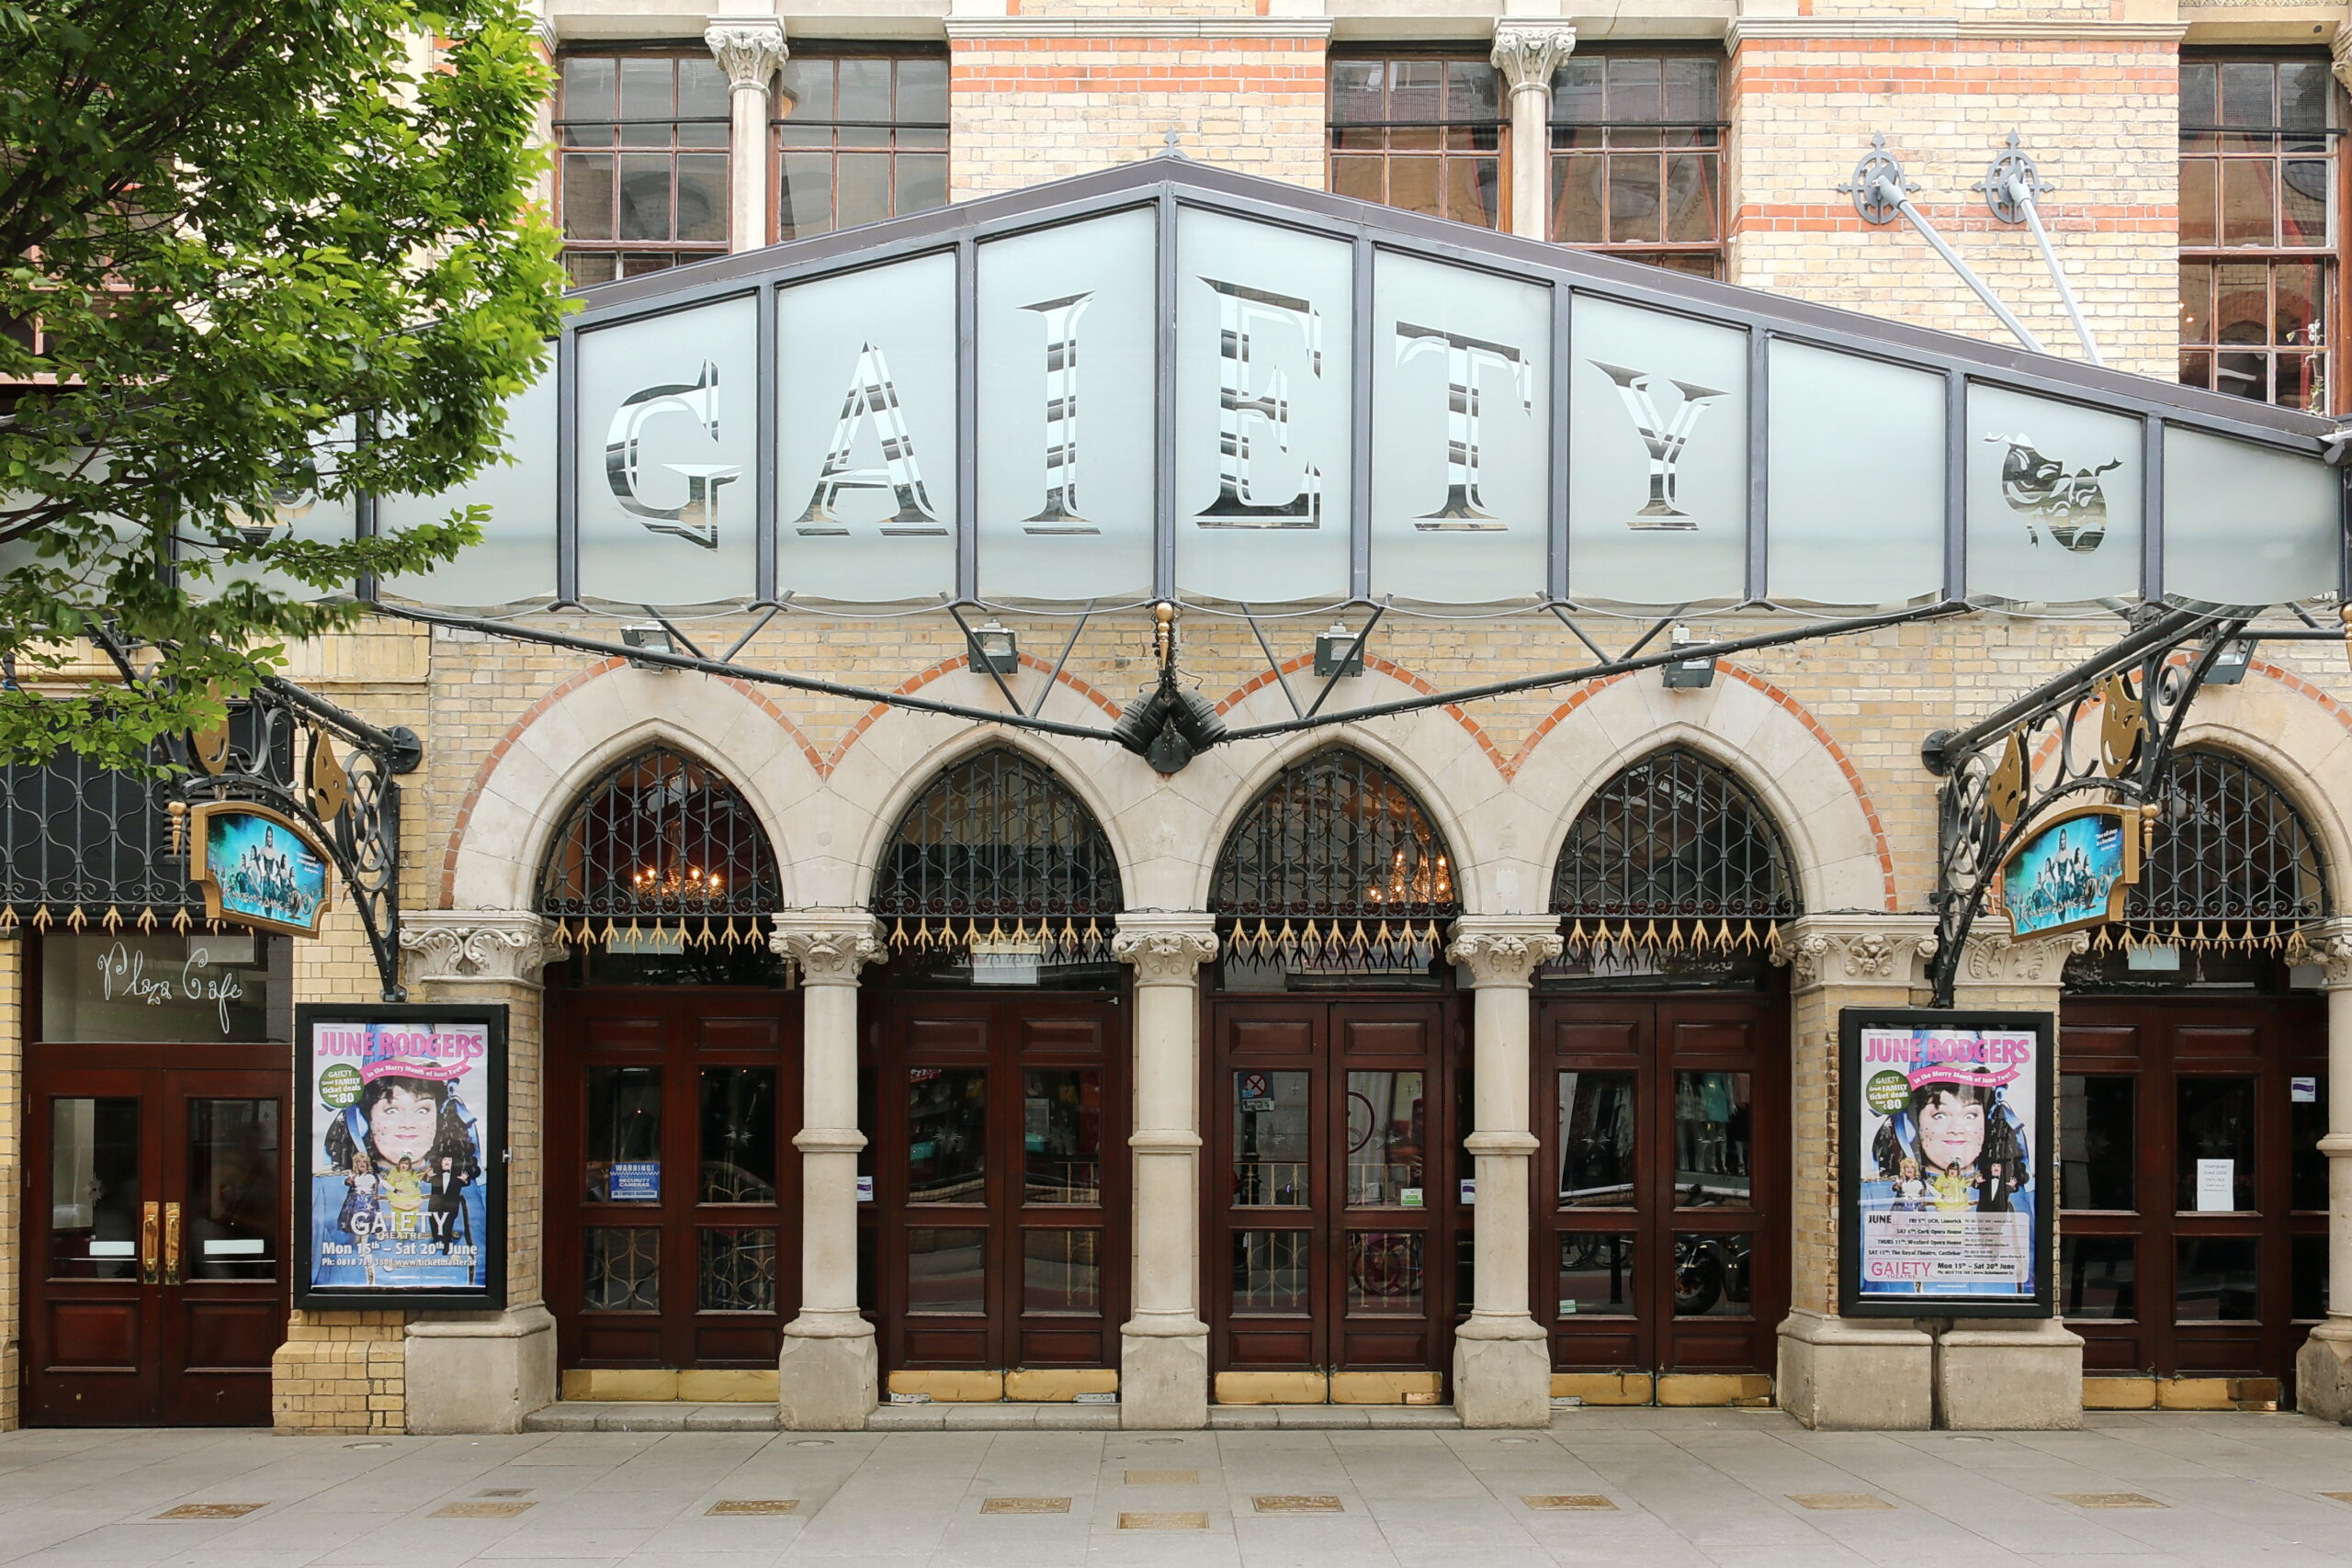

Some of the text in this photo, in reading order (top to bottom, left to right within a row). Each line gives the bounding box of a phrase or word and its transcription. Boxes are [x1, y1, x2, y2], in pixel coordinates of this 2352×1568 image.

[604, 275, 1733, 551] GAIETY
[97, 942, 243, 1034] Plaza Cafe
[318, 1032, 483, 1058] JUNE RODGERS
[1865, 1038, 2030, 1063] JUNE RODGERS
[328, 1069, 352, 1077] GAIETY
[374, 1066, 384, 1075] the
[405, 1066, 424, 1076] Month
[448, 1066, 463, 1076] Tour
[1953, 1072, 1973, 1081] Month
[1997, 1071, 2012, 1081] Tour
[334, 1077, 361, 1086] FAMILY
[1875, 1076, 1900, 1084] GAIETY
[1882, 1084, 1908, 1092] FAMILY
[1870, 1092, 1889, 1100] ticket
[351, 1211, 450, 1236] GAIETY
[1868, 1214, 1892, 1224] JUNE
[376, 1232, 424, 1240] THEATRE
[322, 1242, 352, 1255] Mon
[356, 1241, 380, 1255] 15th
[395, 1242, 416, 1255] Sat
[420, 1241, 445, 1255] 20th
[448, 1242, 478, 1255] June
[322, 1258, 334, 1266] Ph:
[336, 1258, 356, 1266] 0818
[395, 1258, 477, 1267] www.ticketmaster.ie
[1871, 1262, 1931, 1277] GAIETY
